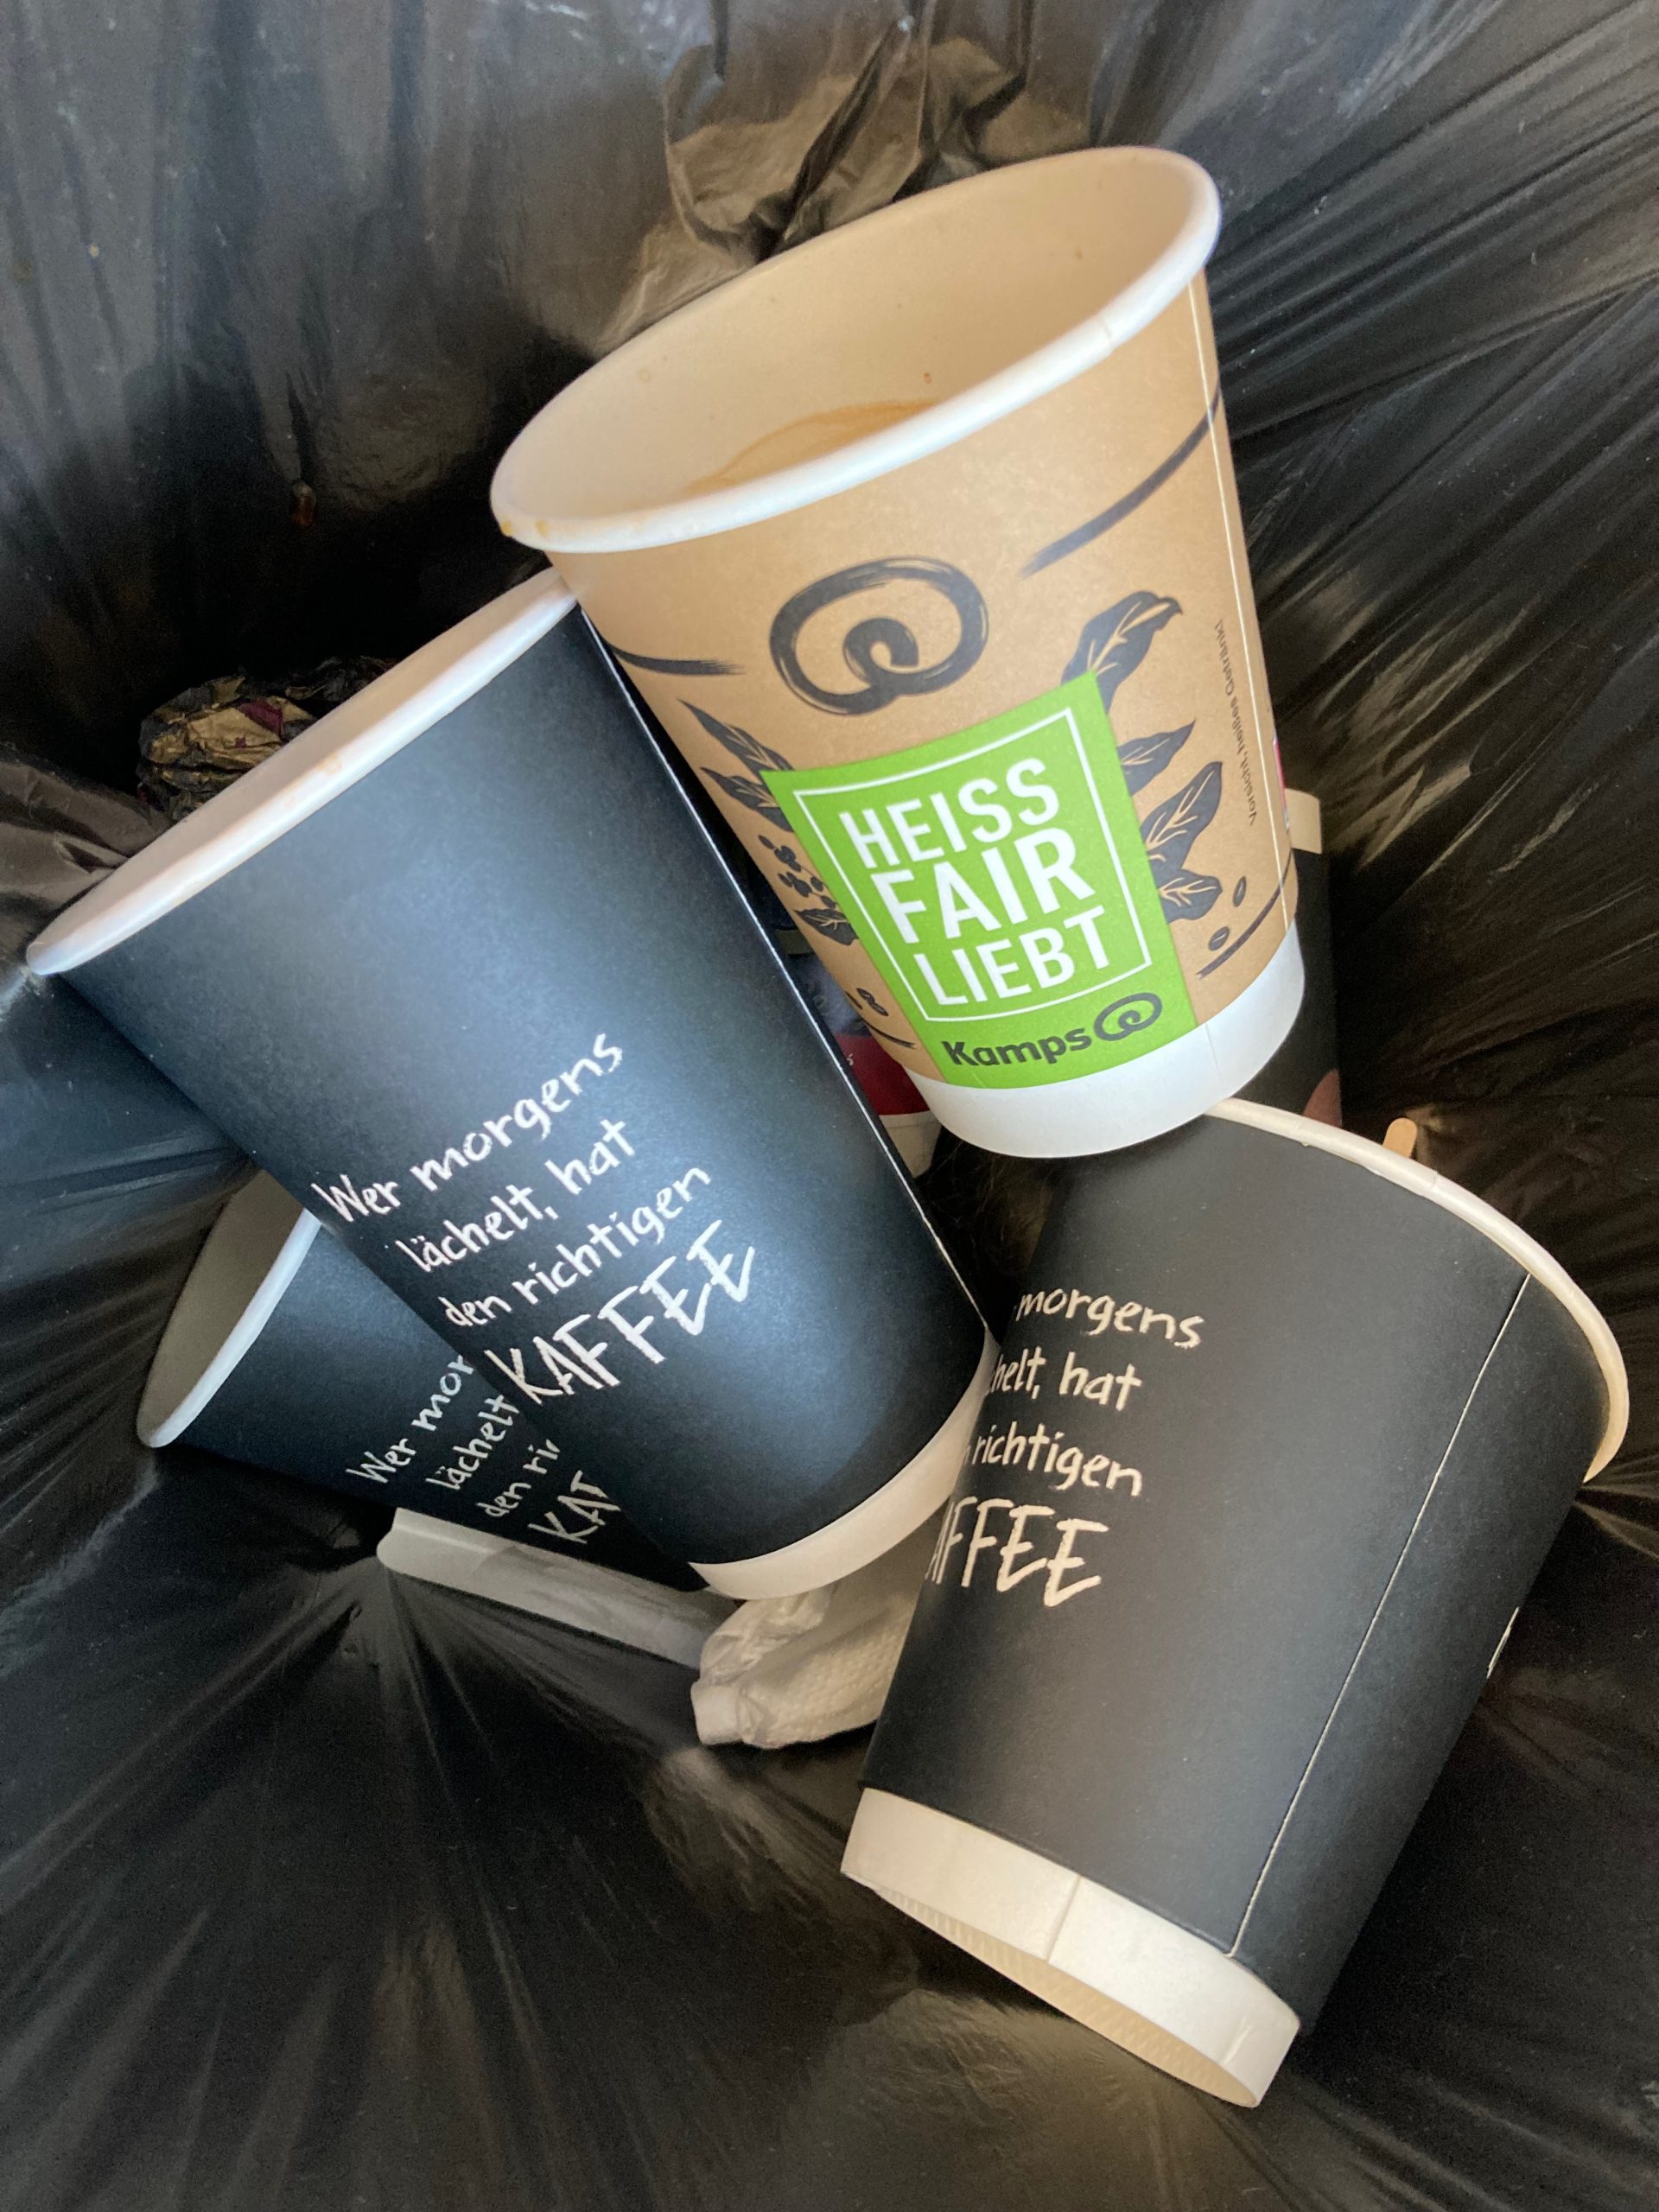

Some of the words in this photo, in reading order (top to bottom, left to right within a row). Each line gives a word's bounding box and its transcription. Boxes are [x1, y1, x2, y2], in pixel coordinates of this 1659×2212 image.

[838, 757, 1060, 869] HEISS
[869, 827, 1096, 944] FAIR
[913, 905, 1110, 1007] LIEBT
[941, 1027, 1093, 1068] Kamps
[310, 1173, 402, 1223] Wer
[410, 1033, 624, 1192] morgens
[395, 1183, 560, 1273] lächelt,
[544, 1117, 636, 1196] hat
[437, 1295, 512, 1328] den
[512, 1166, 713, 1306] richtigen
[483, 1219, 756, 1405] KAFFEE
[1016, 1288, 1205, 1349] morgens
[990, 1346, 1046, 1400] helt,
[1058, 1351, 1142, 1411] hat
[346, 1437, 416, 1484] Wer
[476, 1481, 532, 1518] den
[971, 1421, 1143, 1497] richtigen
[925, 1496, 1109, 1608] AFFEE
